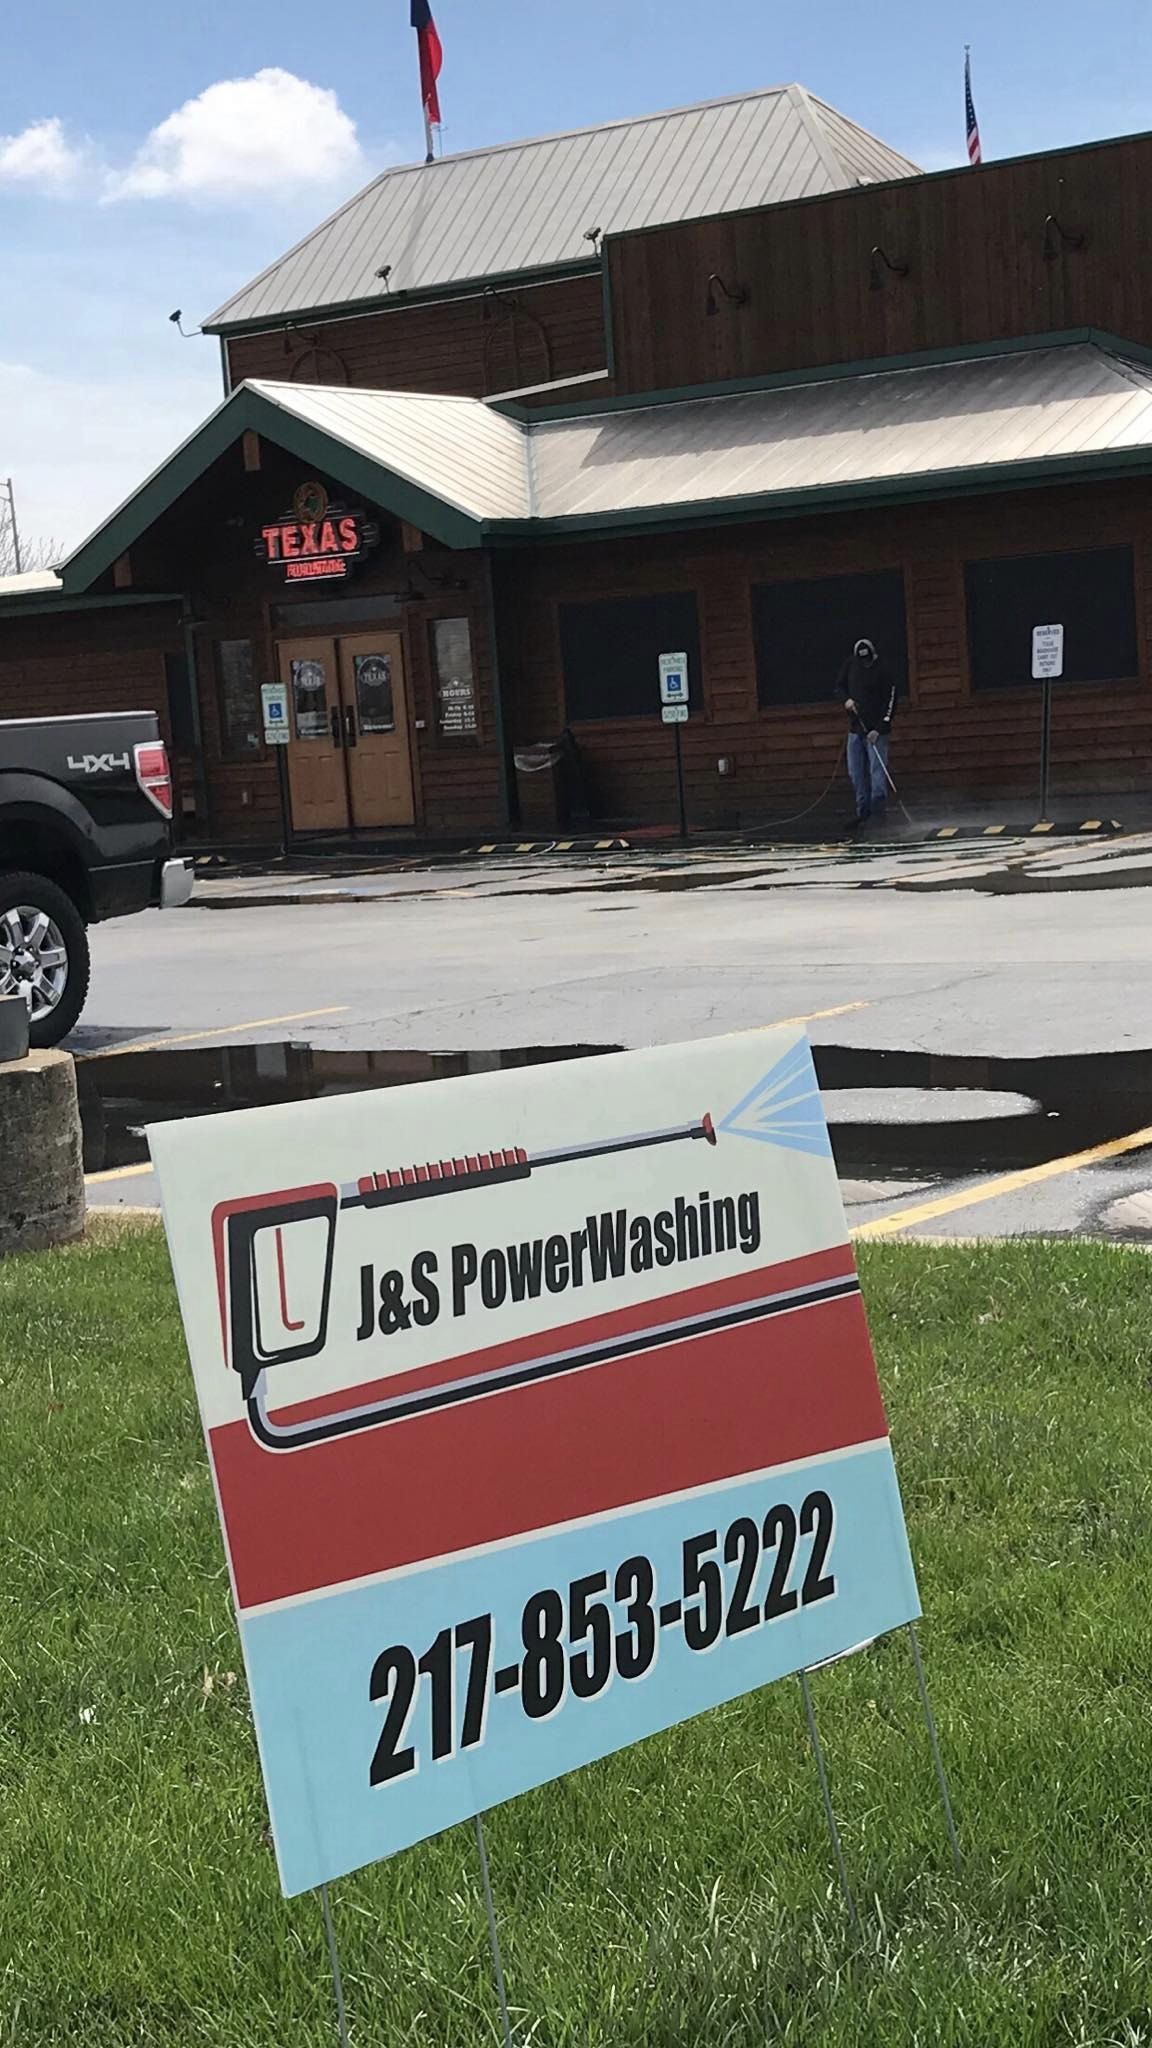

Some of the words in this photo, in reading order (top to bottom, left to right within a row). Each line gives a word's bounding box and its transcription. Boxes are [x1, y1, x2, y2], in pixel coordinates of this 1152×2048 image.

[262, 518, 358, 559] TEXAS
[442, 688, 471, 697] HOURS
[356, 1250, 440, 1341] J&S
[451, 1191, 761, 1317] PowerWashing
[369, 1490, 835, 1788] 217-853-5222
